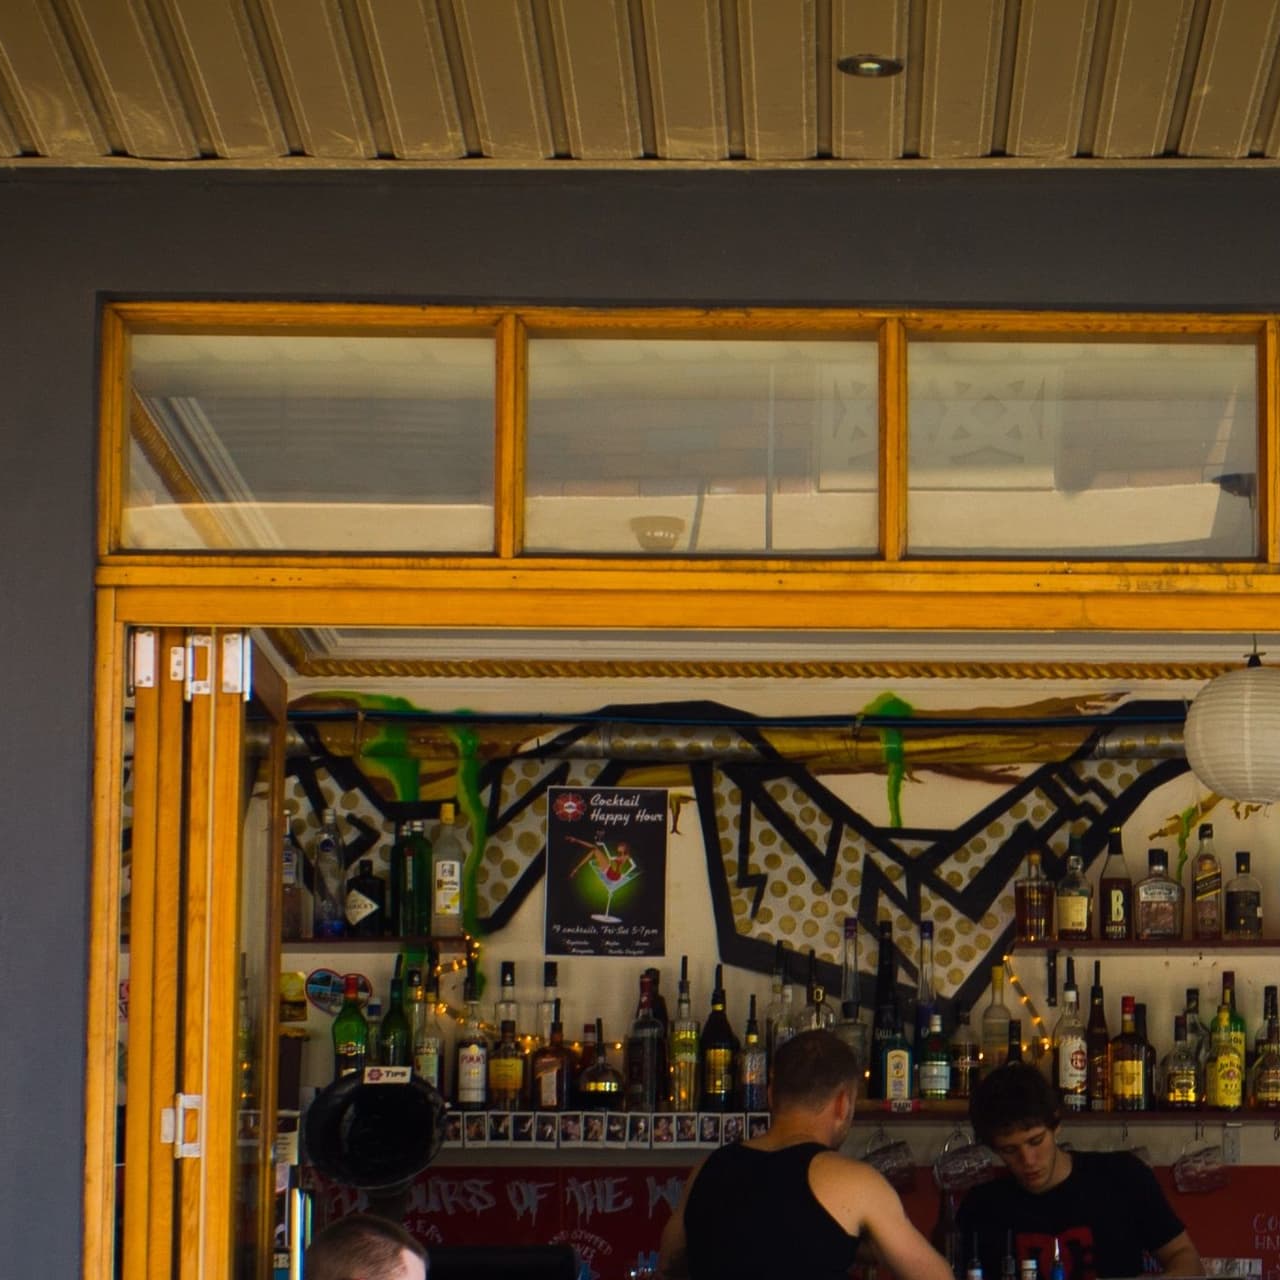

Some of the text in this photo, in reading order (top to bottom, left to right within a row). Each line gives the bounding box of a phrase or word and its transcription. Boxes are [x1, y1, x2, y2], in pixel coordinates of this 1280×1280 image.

[589, 793, 640, 807] Cocktail
[589, 808, 664, 826] Happy Hour
[1111, 889, 1125, 921] B
[507, 1177, 558, 1228] OF
[566, 1176, 634, 1224] THE
